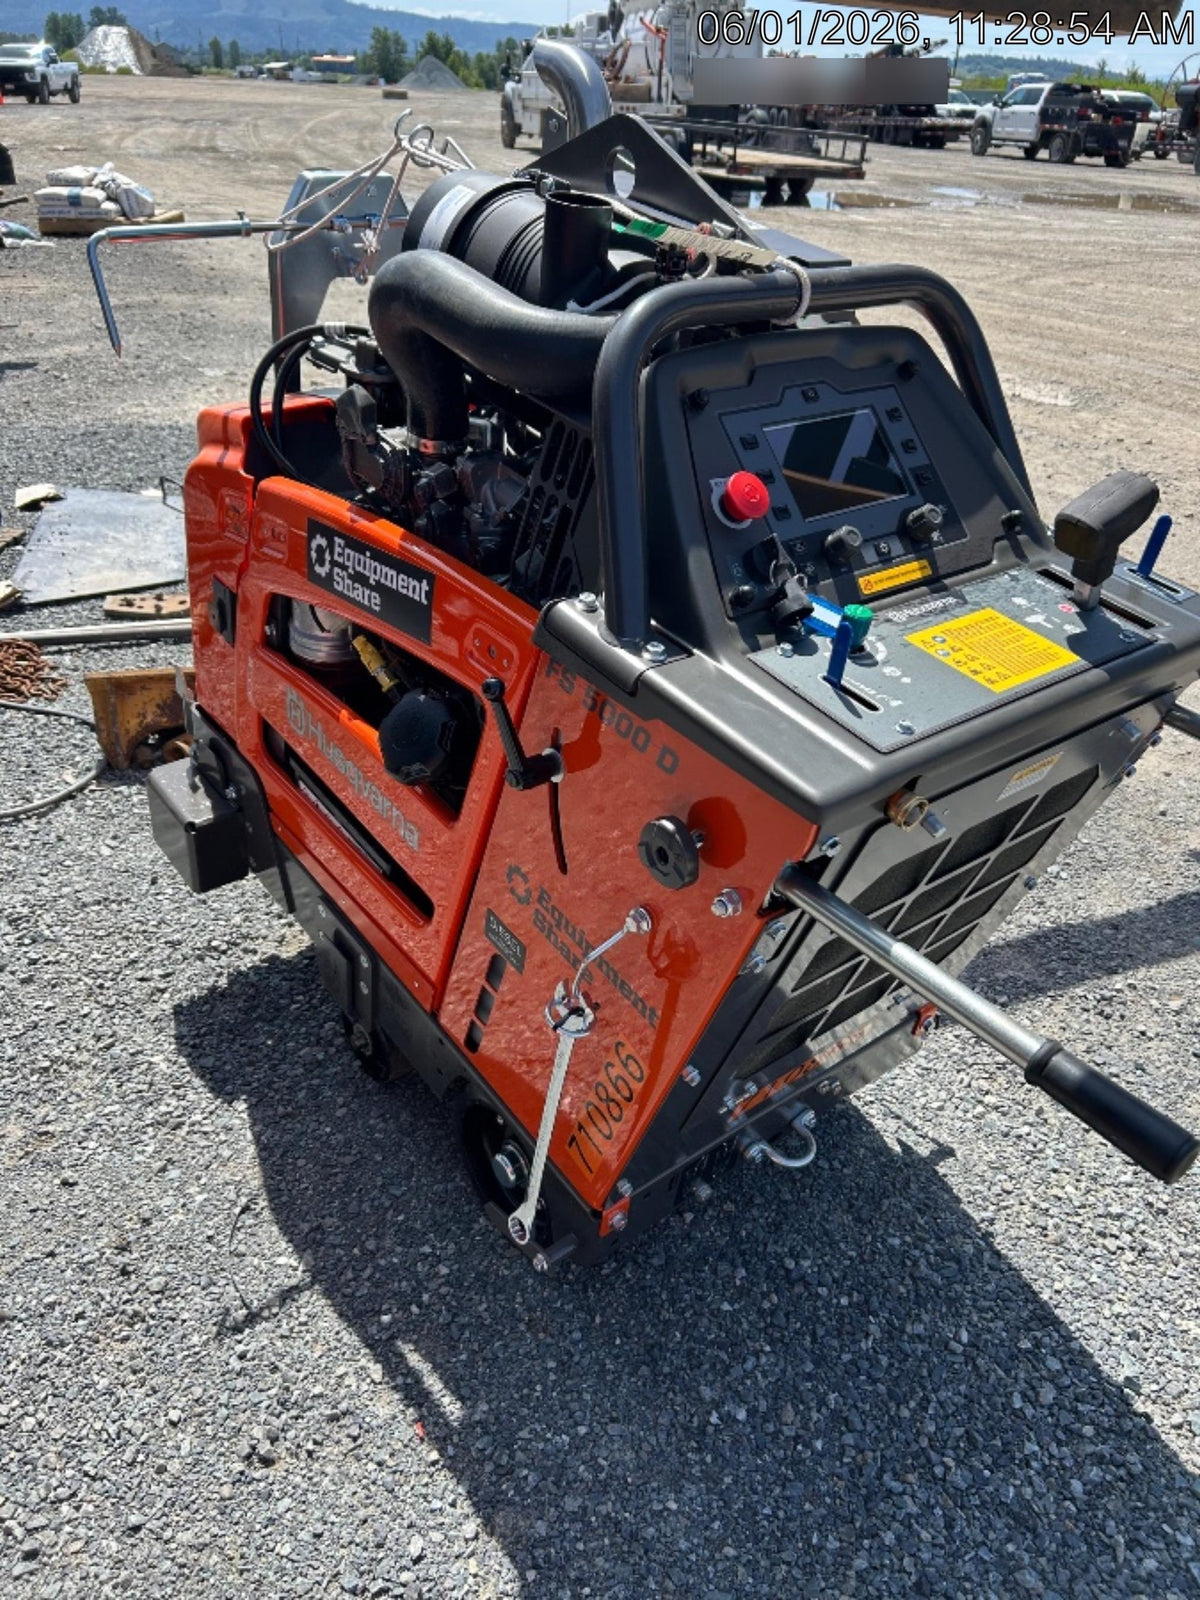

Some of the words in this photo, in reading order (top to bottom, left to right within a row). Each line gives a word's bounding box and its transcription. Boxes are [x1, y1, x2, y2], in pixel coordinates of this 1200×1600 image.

[333, 536, 430, 605] Equipment
[333, 566, 382, 612] Share
[545, 660, 577, 695] FS
[581, 687, 652, 753] 5000
[656, 744, 680, 775] D
[307, 716, 421, 851] Husqvarna
[567, 1040, 645, 1174] 710866
